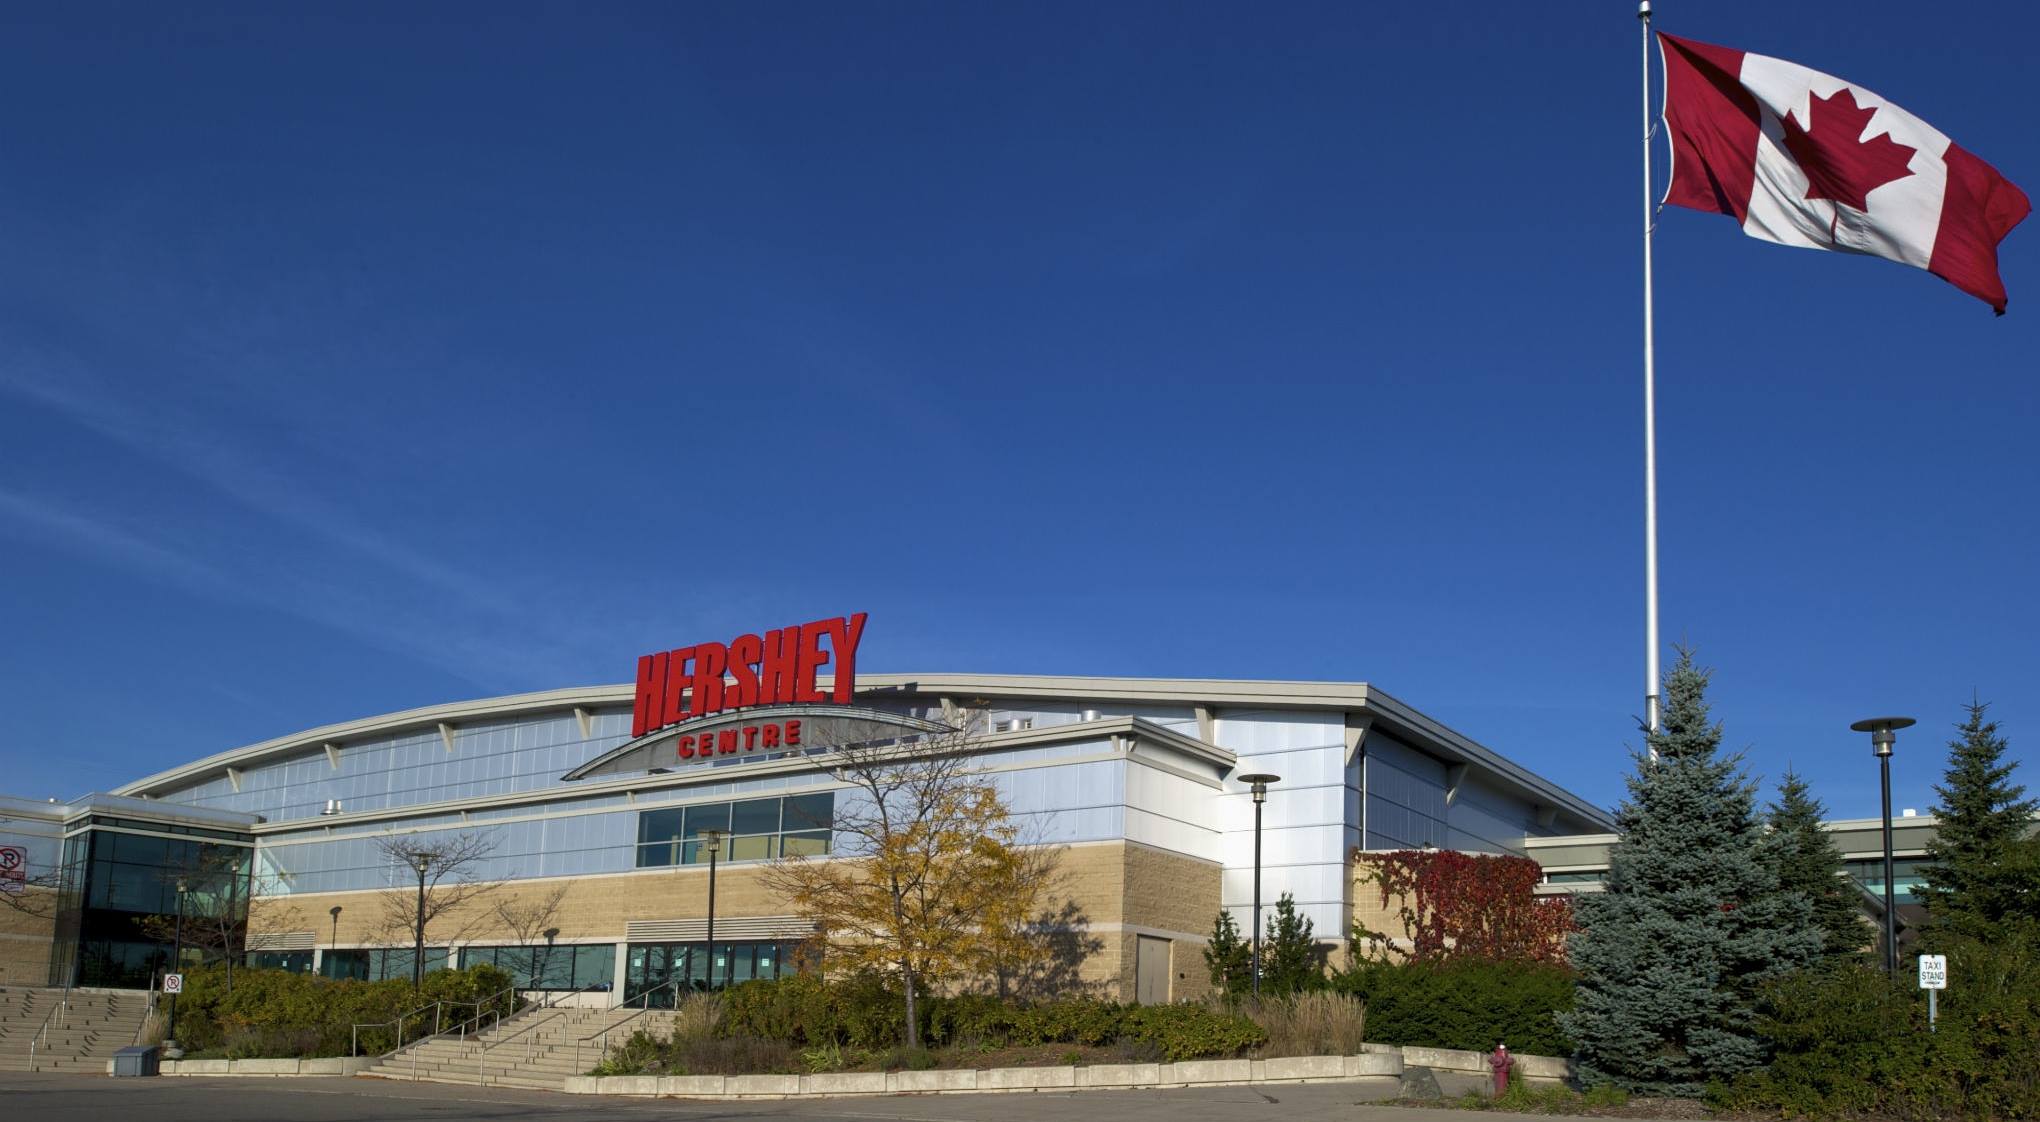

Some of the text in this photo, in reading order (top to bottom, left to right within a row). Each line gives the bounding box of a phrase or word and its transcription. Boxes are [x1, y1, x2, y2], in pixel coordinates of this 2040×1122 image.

[631, 612, 868, 739] HERSHEY
[677, 719, 802, 760] CENTRE
[1921, 971, 1945, 981] STAND
[1923, 961, 1942, 970] TAXI
